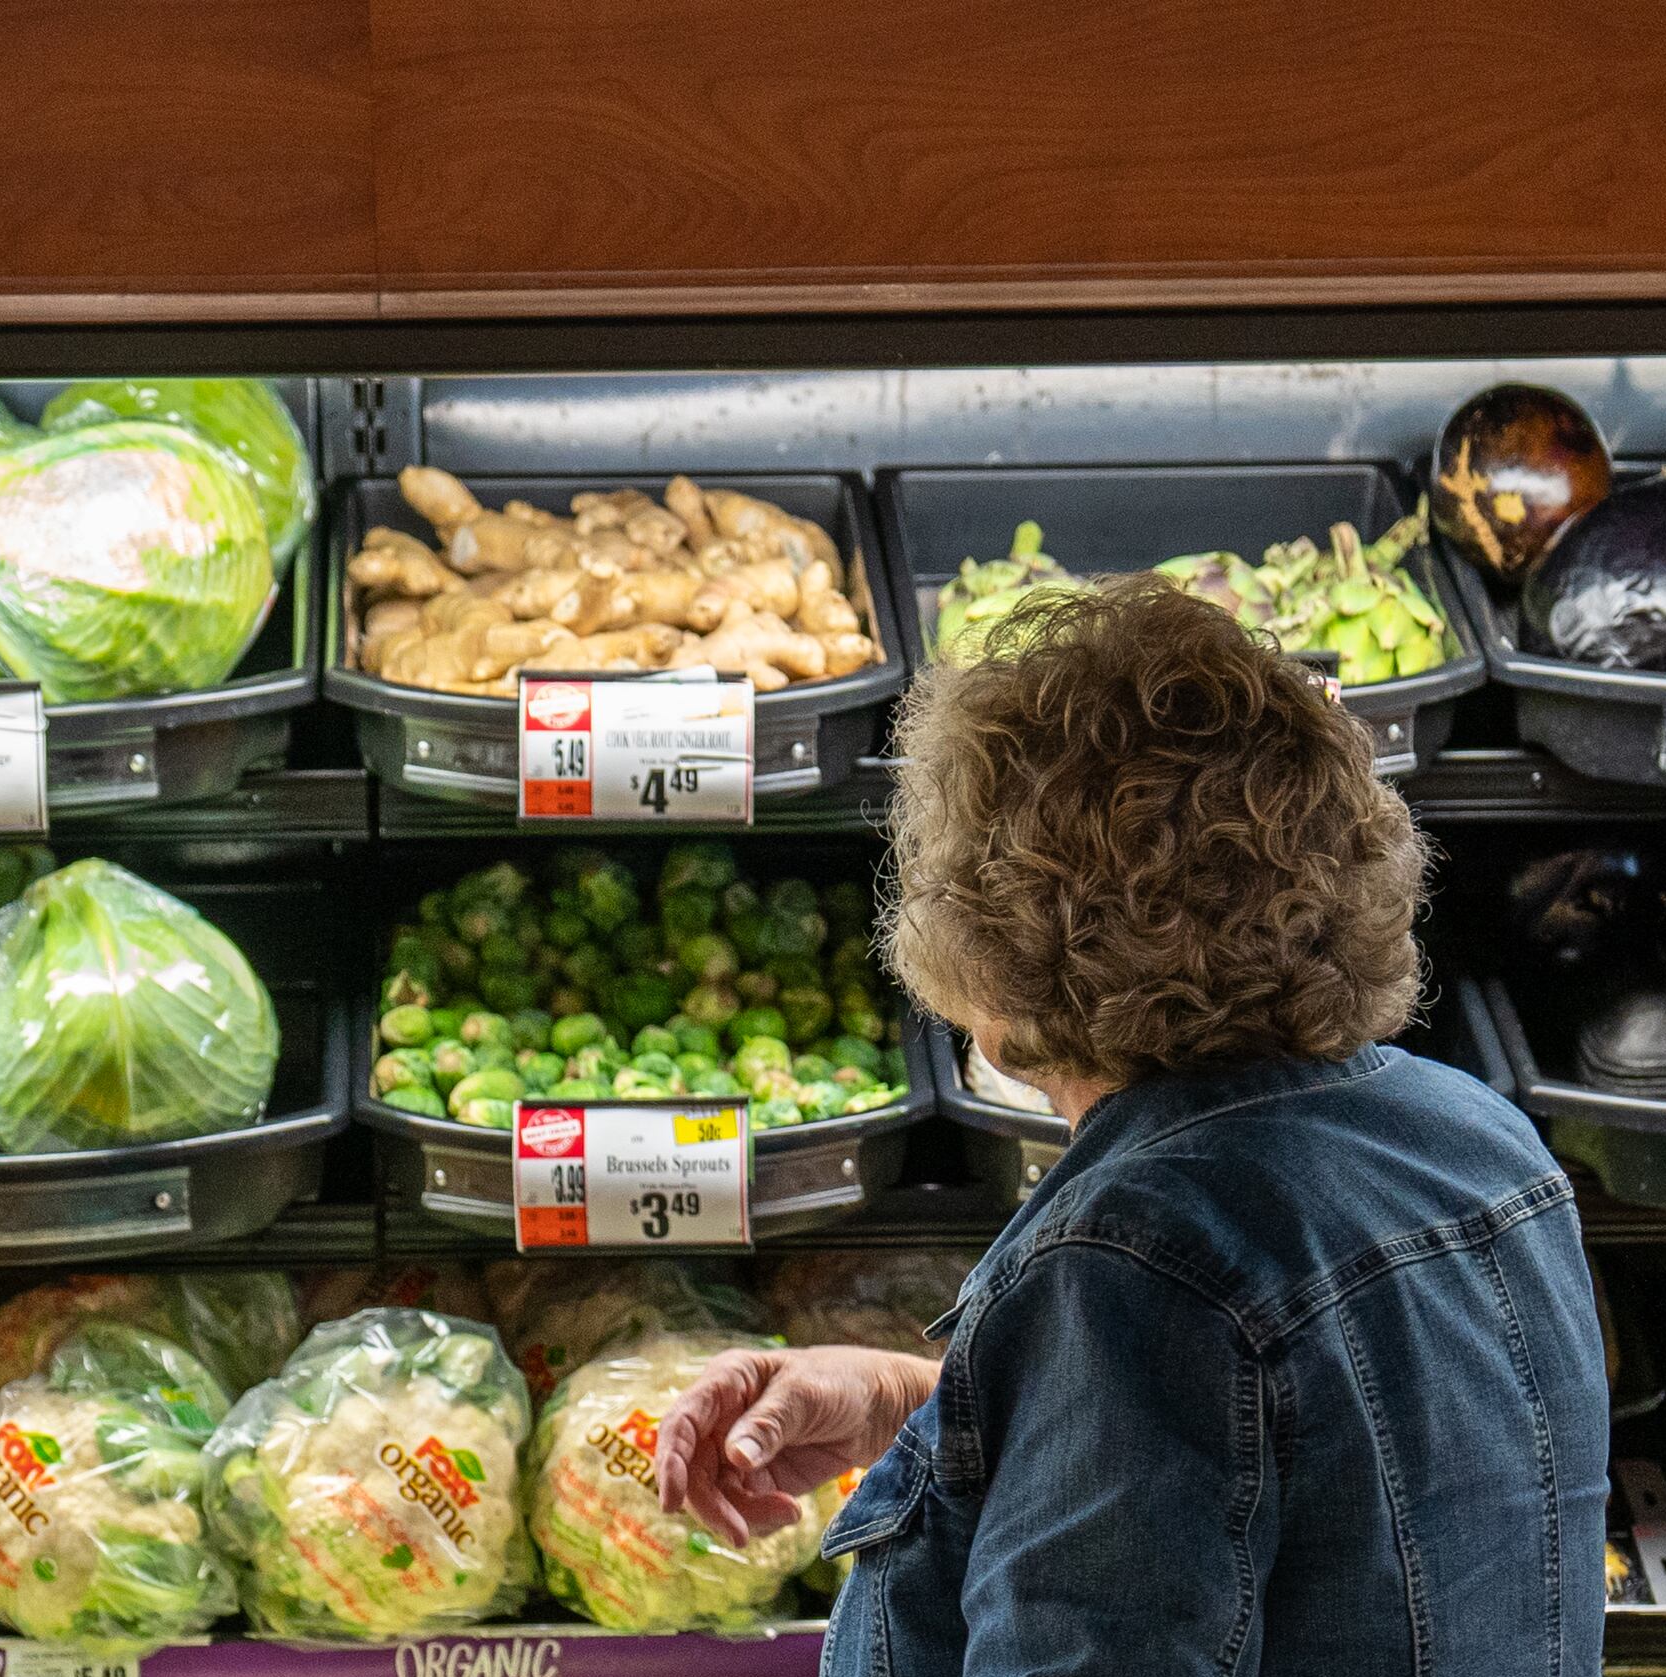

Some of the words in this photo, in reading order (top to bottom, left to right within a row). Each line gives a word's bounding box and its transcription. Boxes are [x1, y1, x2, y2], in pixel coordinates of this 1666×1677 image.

[607, 1156, 667, 1172] Brussels
[673, 1157, 730, 1176] Sprouts
[619, 1408, 659, 1460] FO
[380, 1443, 476, 1553] organic
